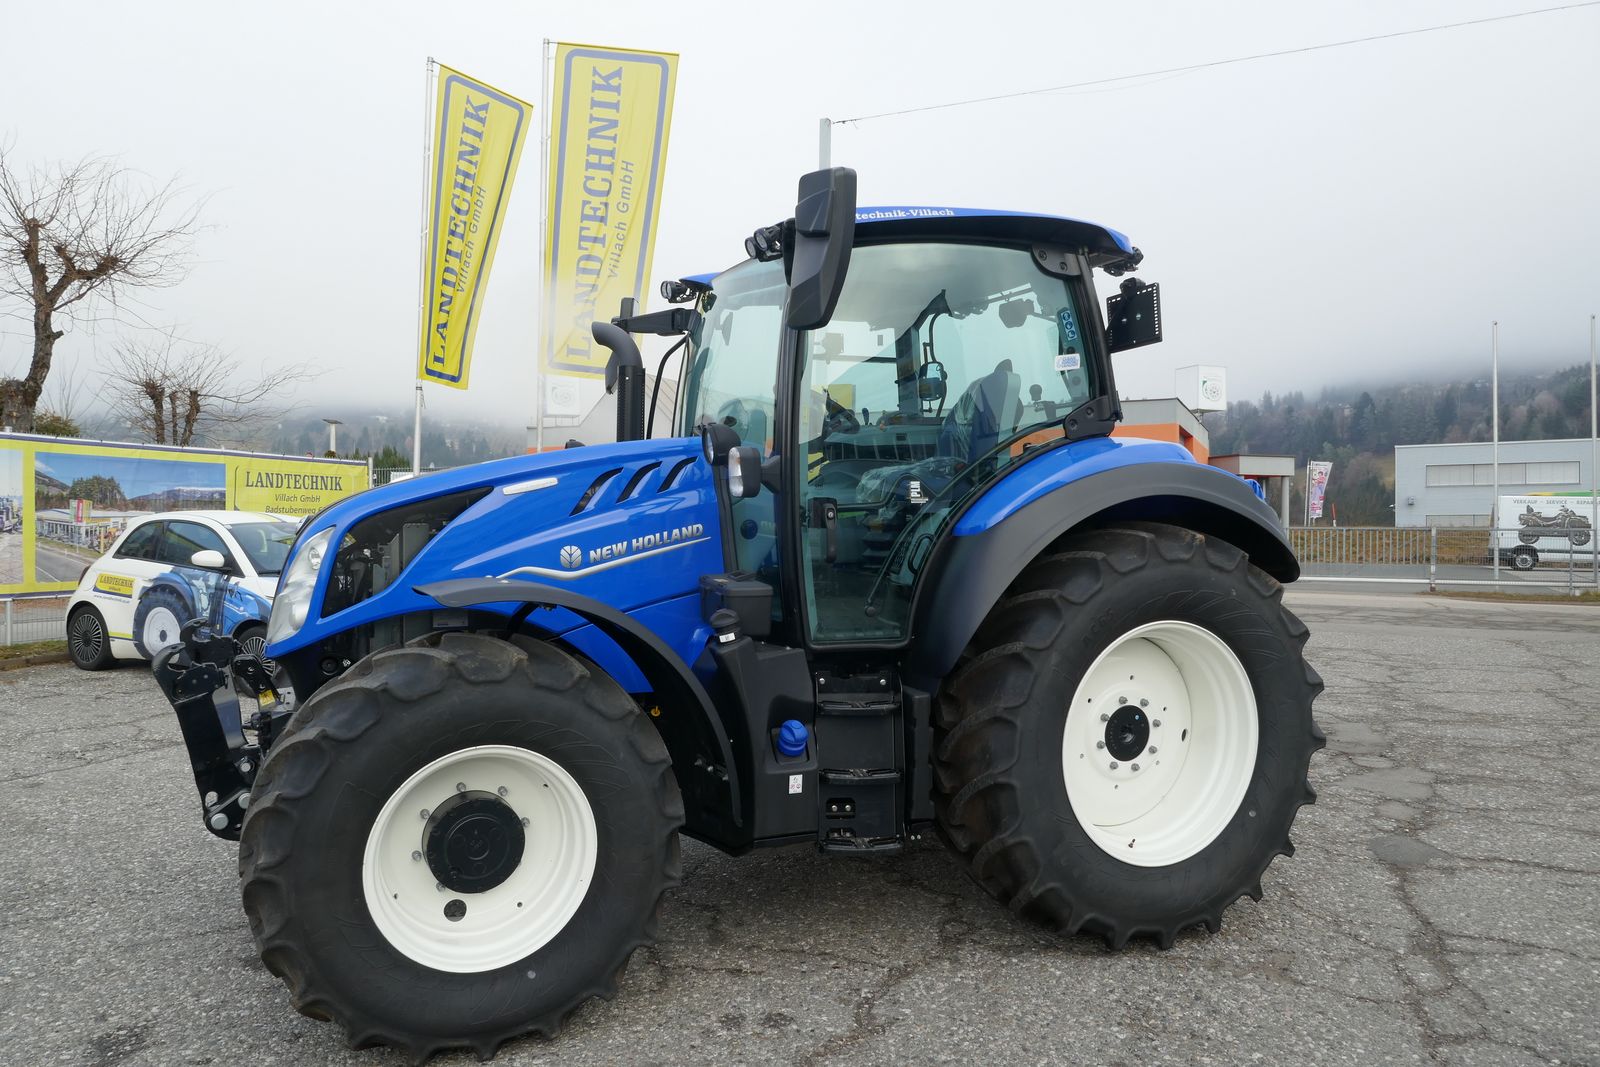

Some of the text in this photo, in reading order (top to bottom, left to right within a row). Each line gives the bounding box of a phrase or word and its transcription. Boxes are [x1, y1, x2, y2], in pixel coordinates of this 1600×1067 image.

[433, 95, 490, 367] LANDTECHNIK
[456, 185, 487, 293] Villach GmbH
[566, 66, 623, 360] LANDTECHNIK
[608, 160, 635, 278] Villach GmbH
[245, 471, 343, 491] LANDTECHNIK
[275, 494, 321, 503] Villach GmbH
[589, 523, 704, 563] NEW HOLLAND
